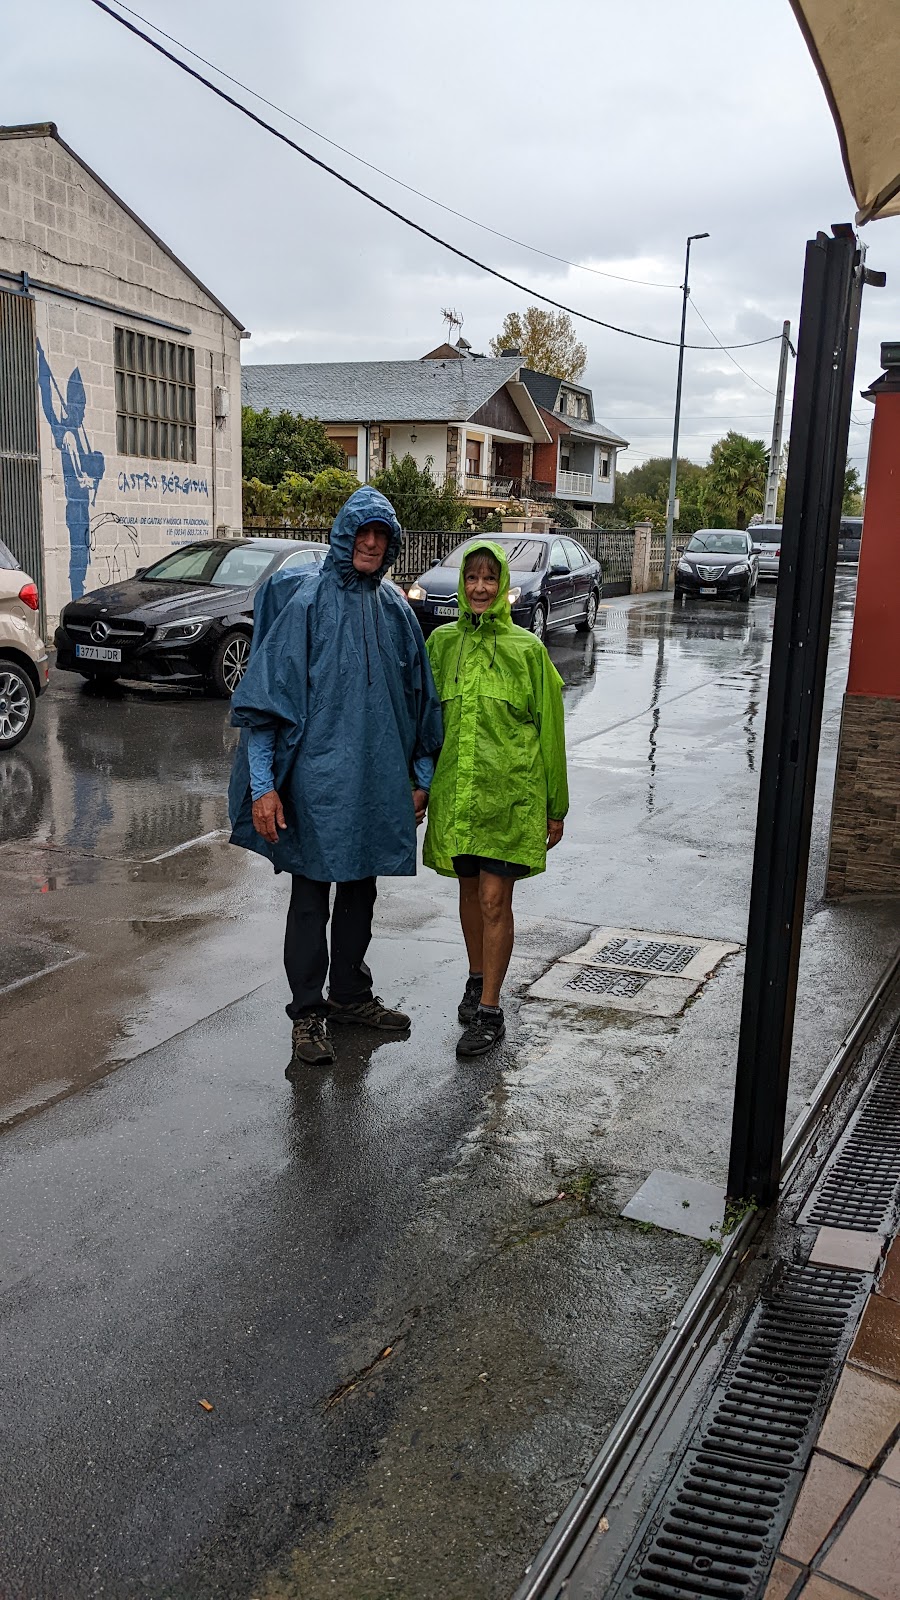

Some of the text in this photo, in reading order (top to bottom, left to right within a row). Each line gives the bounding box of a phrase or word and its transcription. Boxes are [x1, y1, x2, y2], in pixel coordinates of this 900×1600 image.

[118, 471, 158, 493] CASTRO
[119, 516, 138, 525] ESCUELA
[140, 517, 147, 525] DE
[147, 517, 162, 525] GAITAS
[183, 518, 209, 526] TRADICIONAL
[439, 607, 455, 616] 4401
[80, 646, 118, 660] 3771 JDR
